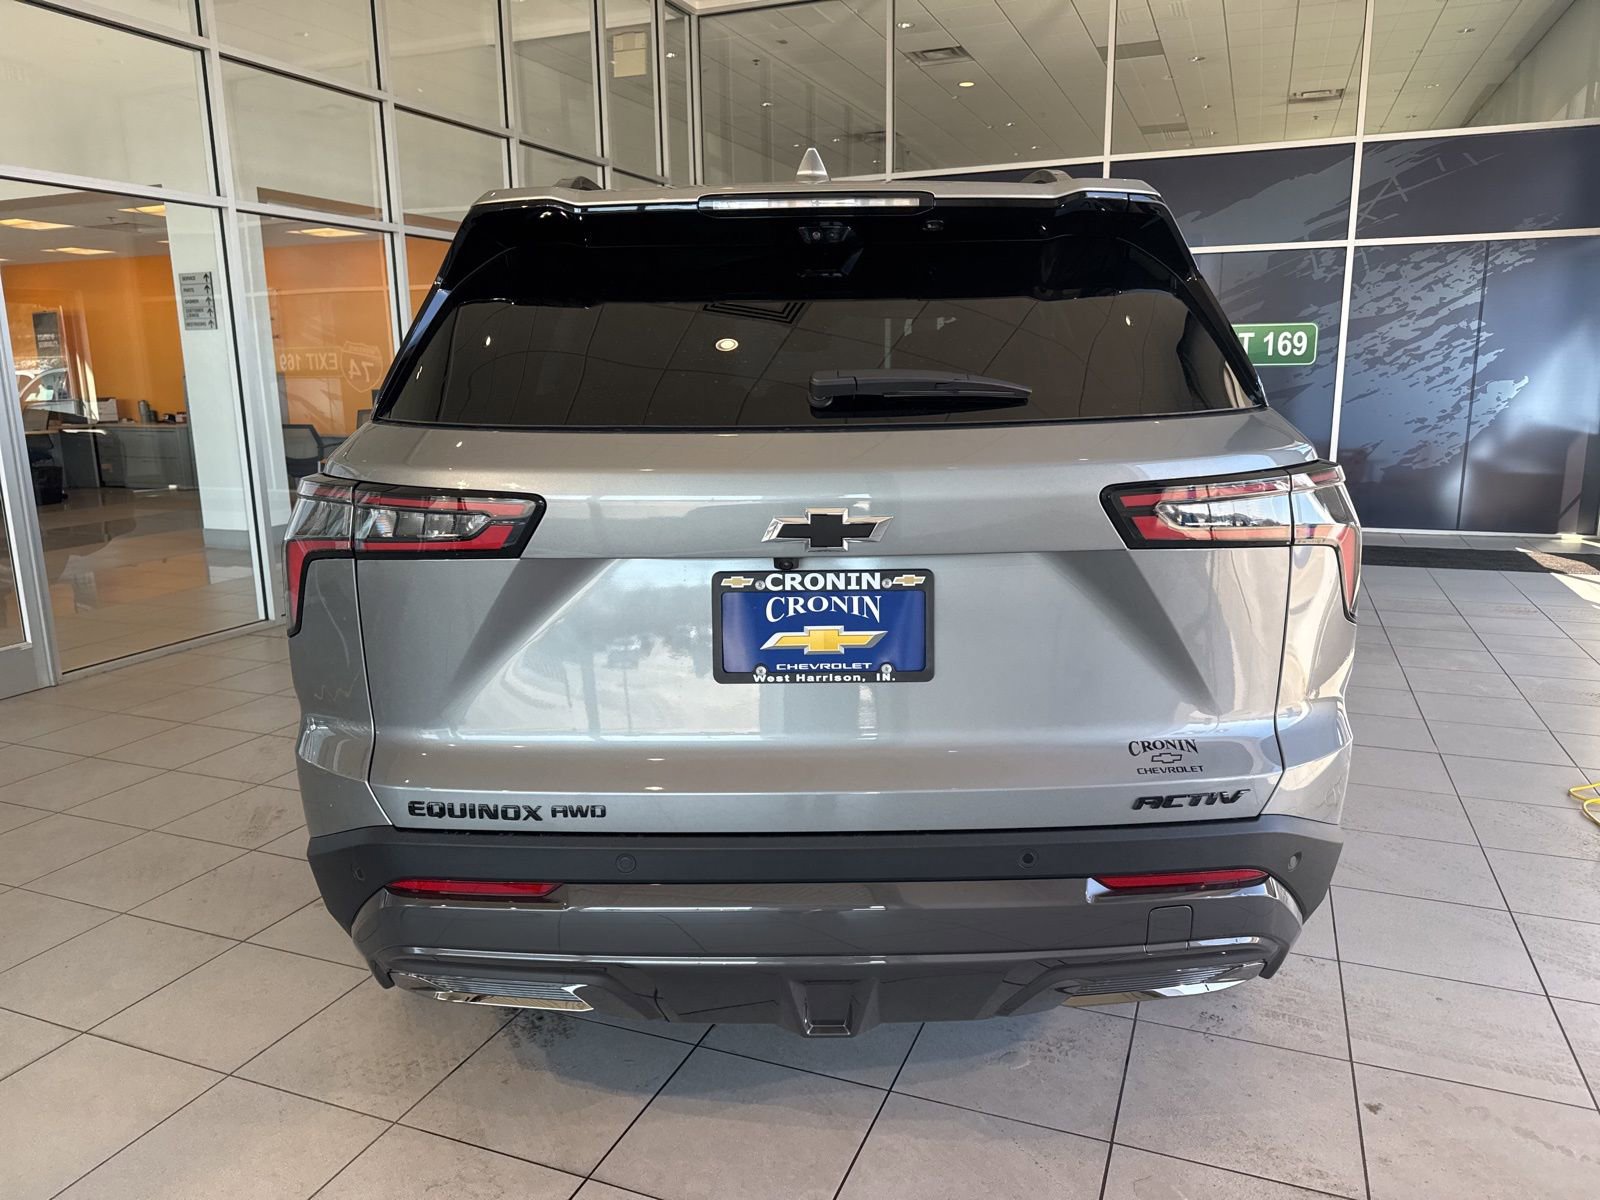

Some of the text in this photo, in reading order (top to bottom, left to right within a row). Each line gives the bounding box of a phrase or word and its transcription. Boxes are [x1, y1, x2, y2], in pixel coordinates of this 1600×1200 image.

[1263, 331, 1308, 356] 169
[764, 573, 881, 591] CRONIN
[765, 595, 882, 623] CRONIN
[776, 662, 873, 670] CHEVROLET
[753, 673, 789, 683] West
[796, 673, 866, 683] Harrison,
[1128, 739, 1199, 757] CRONIN
[1136, 765, 1204, 775] CHEVROLET
[1131, 788, 1251, 810] ACTIV
[407, 800, 607, 821] EQUINOX AWD
